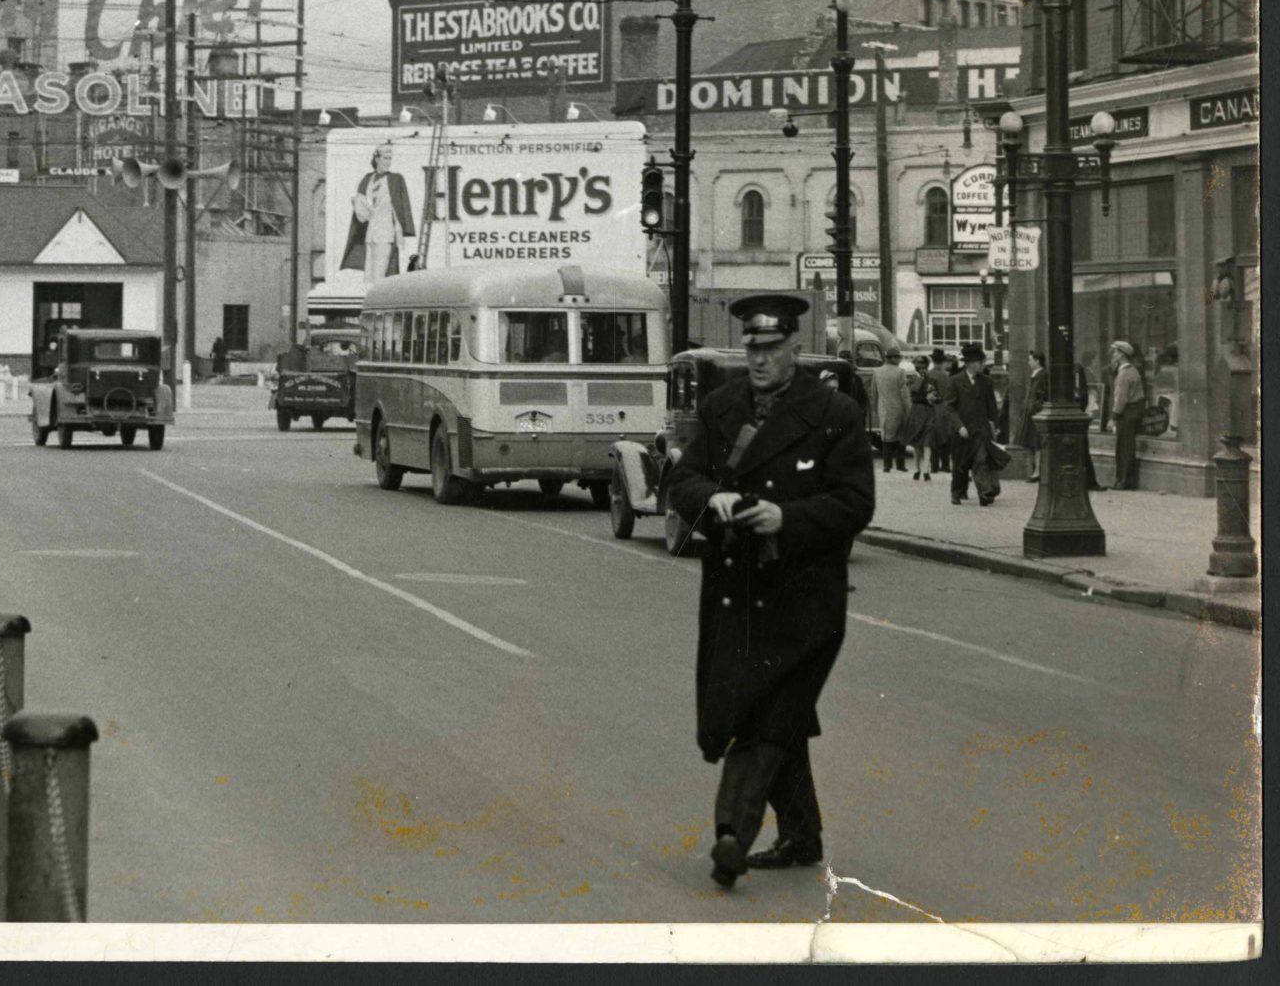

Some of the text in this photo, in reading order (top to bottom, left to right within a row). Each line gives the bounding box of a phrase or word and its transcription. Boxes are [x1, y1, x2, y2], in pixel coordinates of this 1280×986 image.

[569, 0, 601, 32] CO.
[460, 40, 524, 55] LIMITED
[402, 62, 436, 85] RED
[485, 57, 518, 80] TEA
[536, 51, 600, 79] COFFEE
[657, 72, 901, 111] DOMINION
[1114, 116, 1142, 133] LINES
[438, 141, 604, 156] DISTINCTION PERSONIFIED
[50, 166, 98, 176] CLAUDE
[421, 165, 612, 222] Henry's
[956, 191, 989, 201] COFFEE
[990, 231, 1004, 242] NO
[463, 247, 572, 259] LAUNDERERS
[997, 246, 1007, 254] IN
[993, 258, 1033, 268] BLOCK
